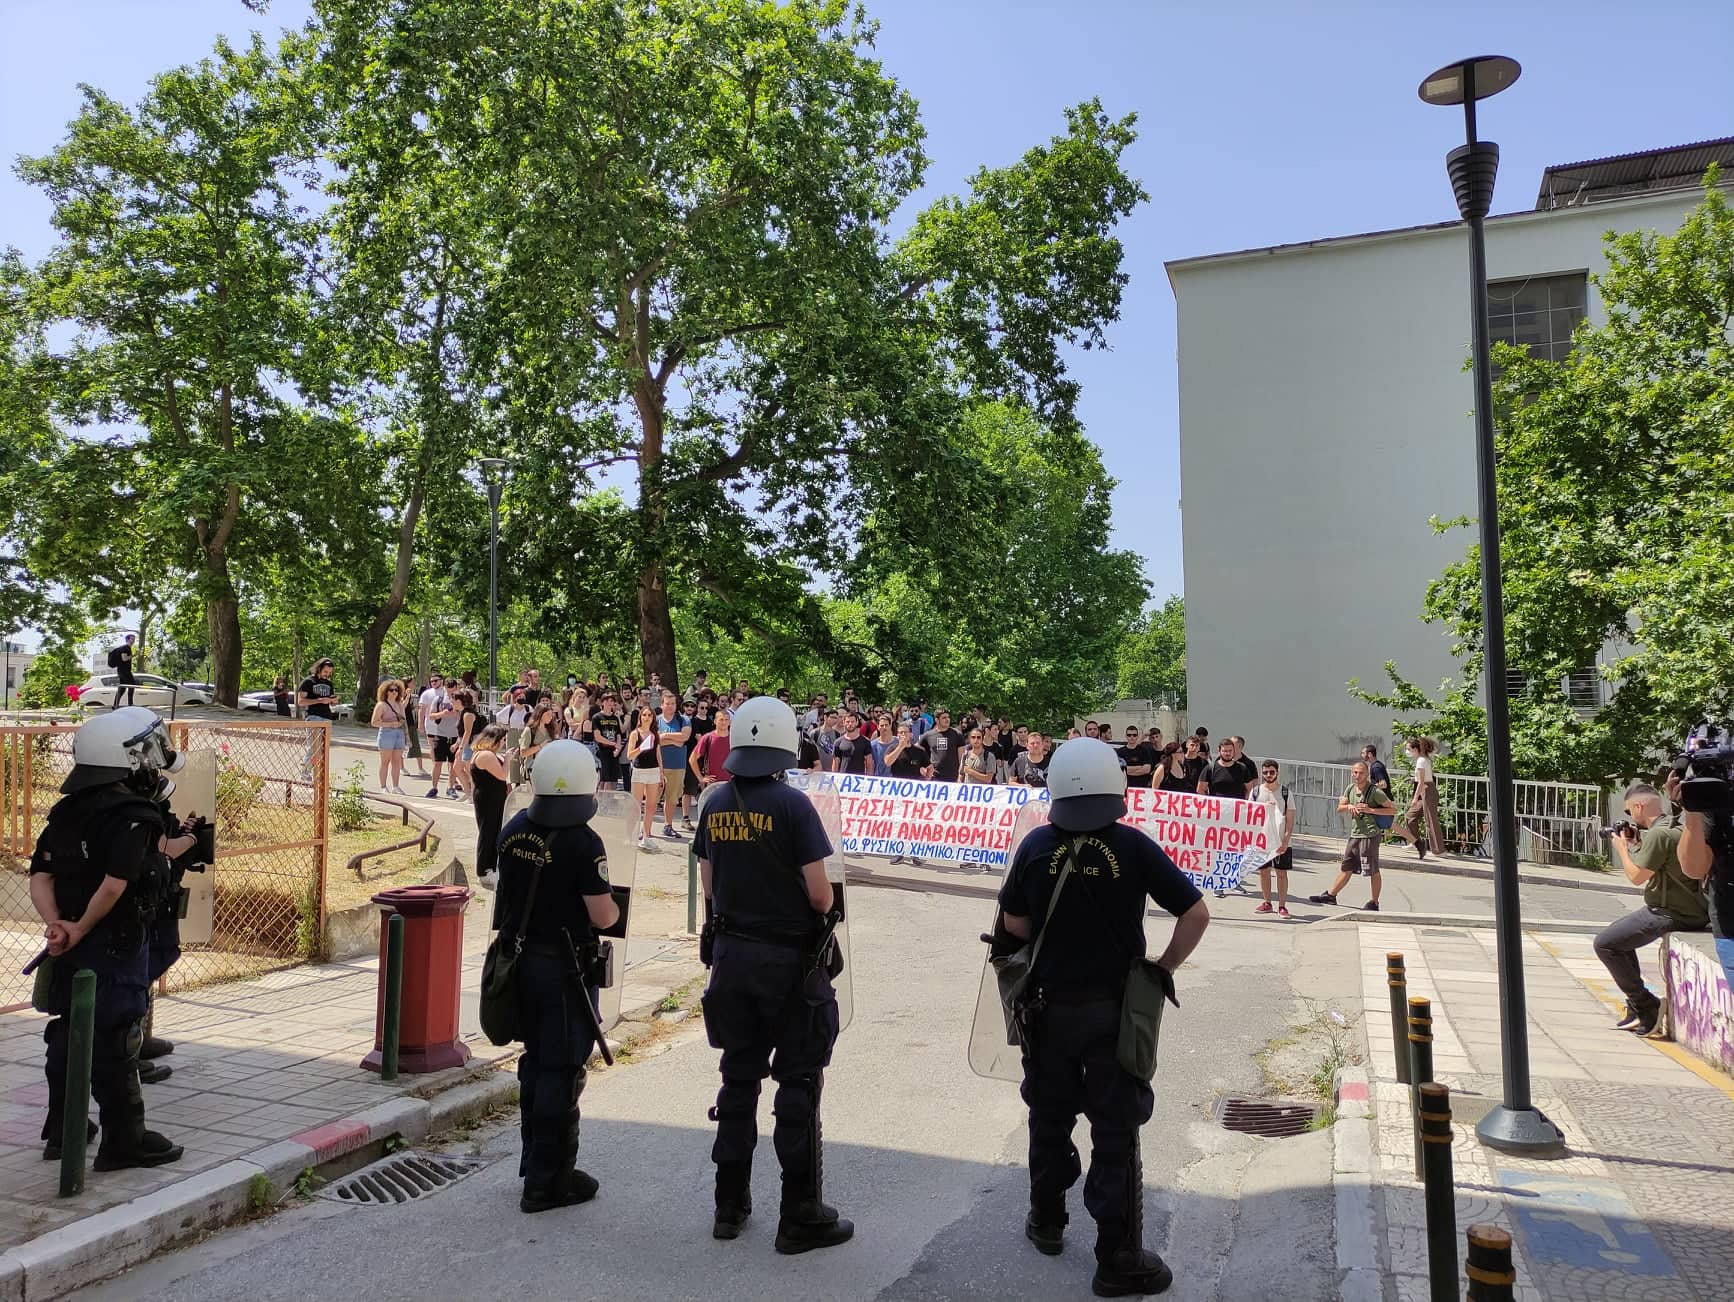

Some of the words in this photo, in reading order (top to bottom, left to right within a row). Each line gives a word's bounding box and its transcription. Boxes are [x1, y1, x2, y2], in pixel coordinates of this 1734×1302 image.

[840, 775, 949, 801] ΑΣΤΥΝΟΜΙΑ
[957, 785, 994, 803] ΑΠΟ
[1005, 786, 1028, 806] ΤΟ
[1152, 790, 1222, 821] ΣΚΕΨΗ
[1234, 800, 1267, 828] ΓΙΑ
[710, 826, 756, 842] POLIC
[841, 817, 894, 839] ΣΤΙΚΗ
[896, 821, 1012, 850] ΑΝΑΒΑΘΜΙΣΗ
[901, 799, 938, 822] ΤΗΣ
[941, 803, 995, 826] ΟΠΠΙ!
[1155, 819, 1197, 847] ΤΟΝ
[1204, 826, 1268, 853] ΑΓΩΝΑ
[511, 847, 537, 861] POLICE
[843, 837, 858, 851] ΚΟ,
[861, 837, 906, 855] ΦΥΣΙΚΟ,
[910, 841, 955, 861] ΧΗΜΙΚΟ,
[956, 848, 1009, 866] ΓΕΩΠΟΝΙ
[1086, 837, 1121, 880] ΣΤΥΝΟΜΙΑ
